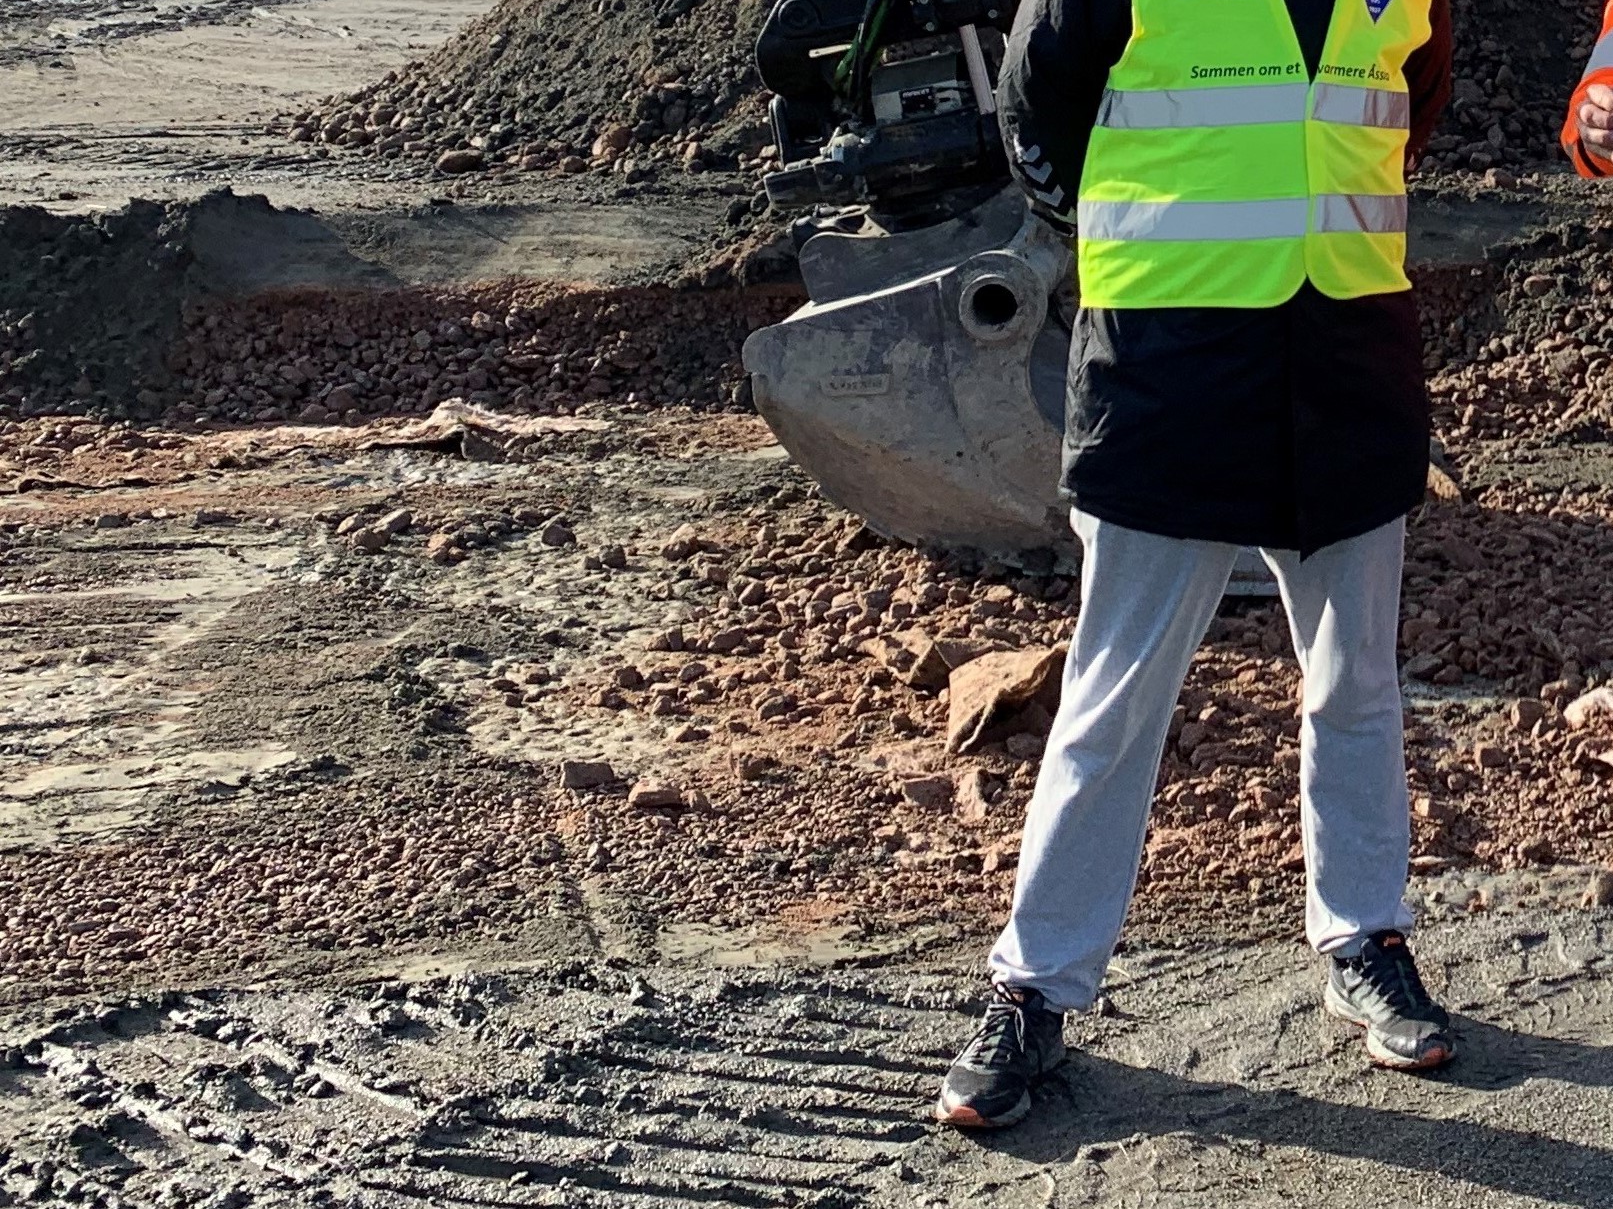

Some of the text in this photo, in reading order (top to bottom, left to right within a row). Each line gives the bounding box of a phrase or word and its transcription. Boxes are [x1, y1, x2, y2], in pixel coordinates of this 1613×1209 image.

[1191, 64, 1255, 79] Sammen
[1259, 66, 1282, 76] om
[1286, 63, 1301, 75] et
[1317, 64, 1366, 79] varmere
